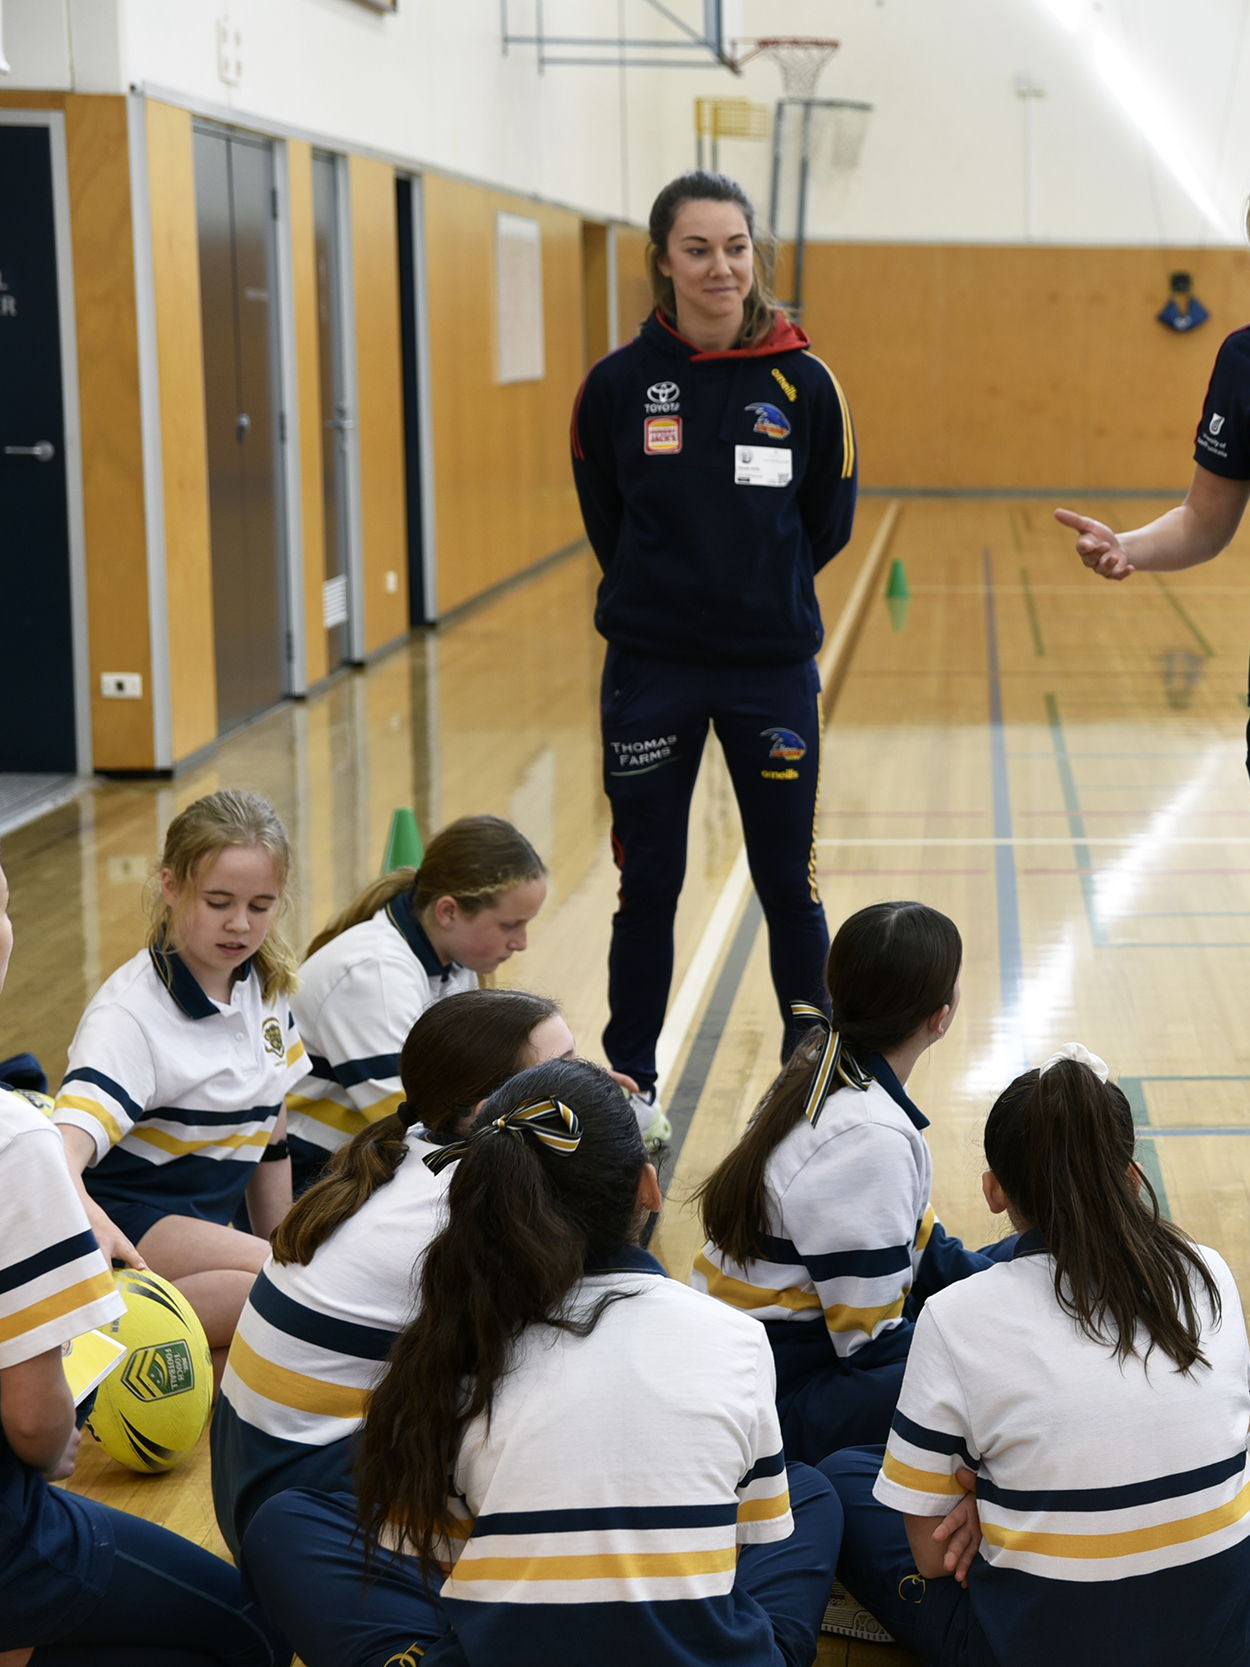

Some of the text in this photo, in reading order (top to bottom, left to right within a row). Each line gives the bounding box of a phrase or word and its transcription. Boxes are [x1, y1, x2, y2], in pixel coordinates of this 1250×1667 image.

[610, 734, 677, 754] THOMAS
[619, 746, 671, 767] FARMS
[165, 1348, 179, 1390] FOOTBALL
